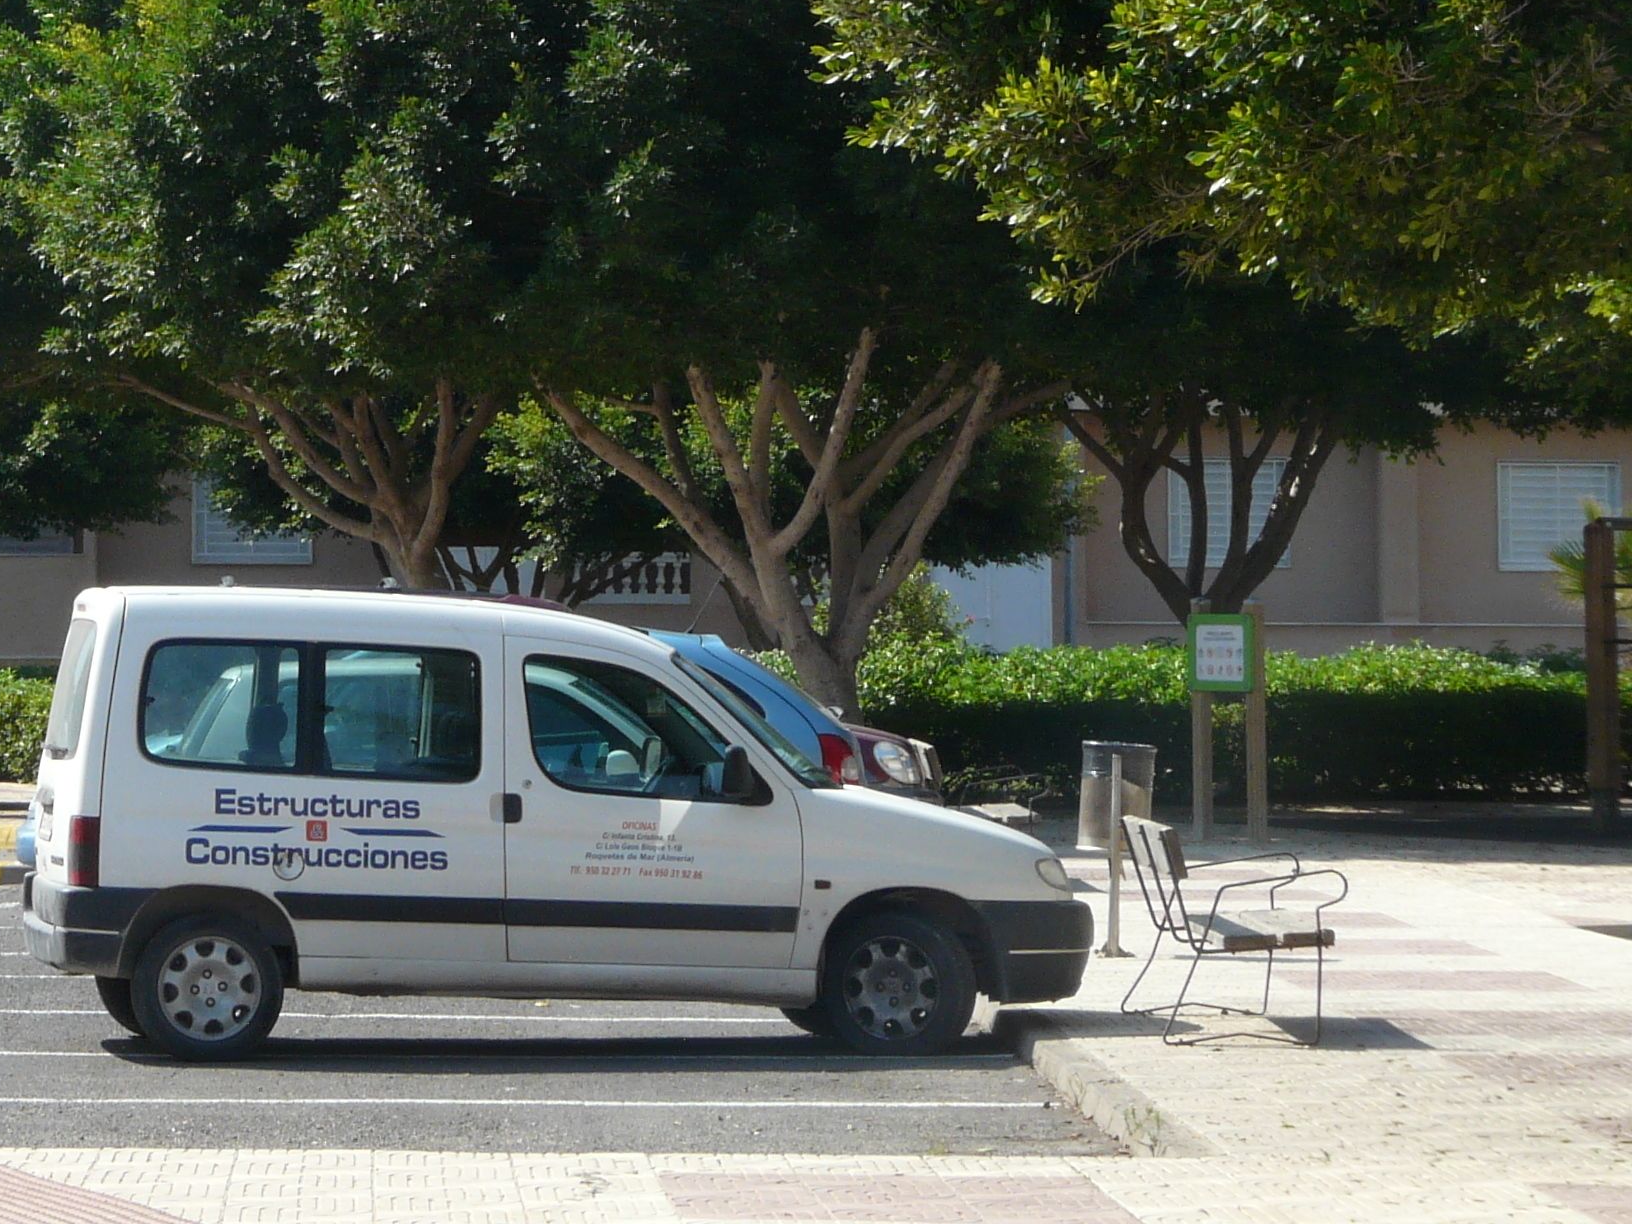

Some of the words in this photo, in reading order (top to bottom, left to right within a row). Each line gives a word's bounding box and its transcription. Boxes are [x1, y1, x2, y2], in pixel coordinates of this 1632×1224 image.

[214, 788, 421, 819] Estructuras
[622, 821, 657, 831] OFICINAS
[185, 838, 449, 871] Construcciones
[585, 852, 624, 861] Roquetas
[627, 853, 637, 861] de
[639, 853, 655, 861] Mar
[639, 867, 653, 877] Fax
